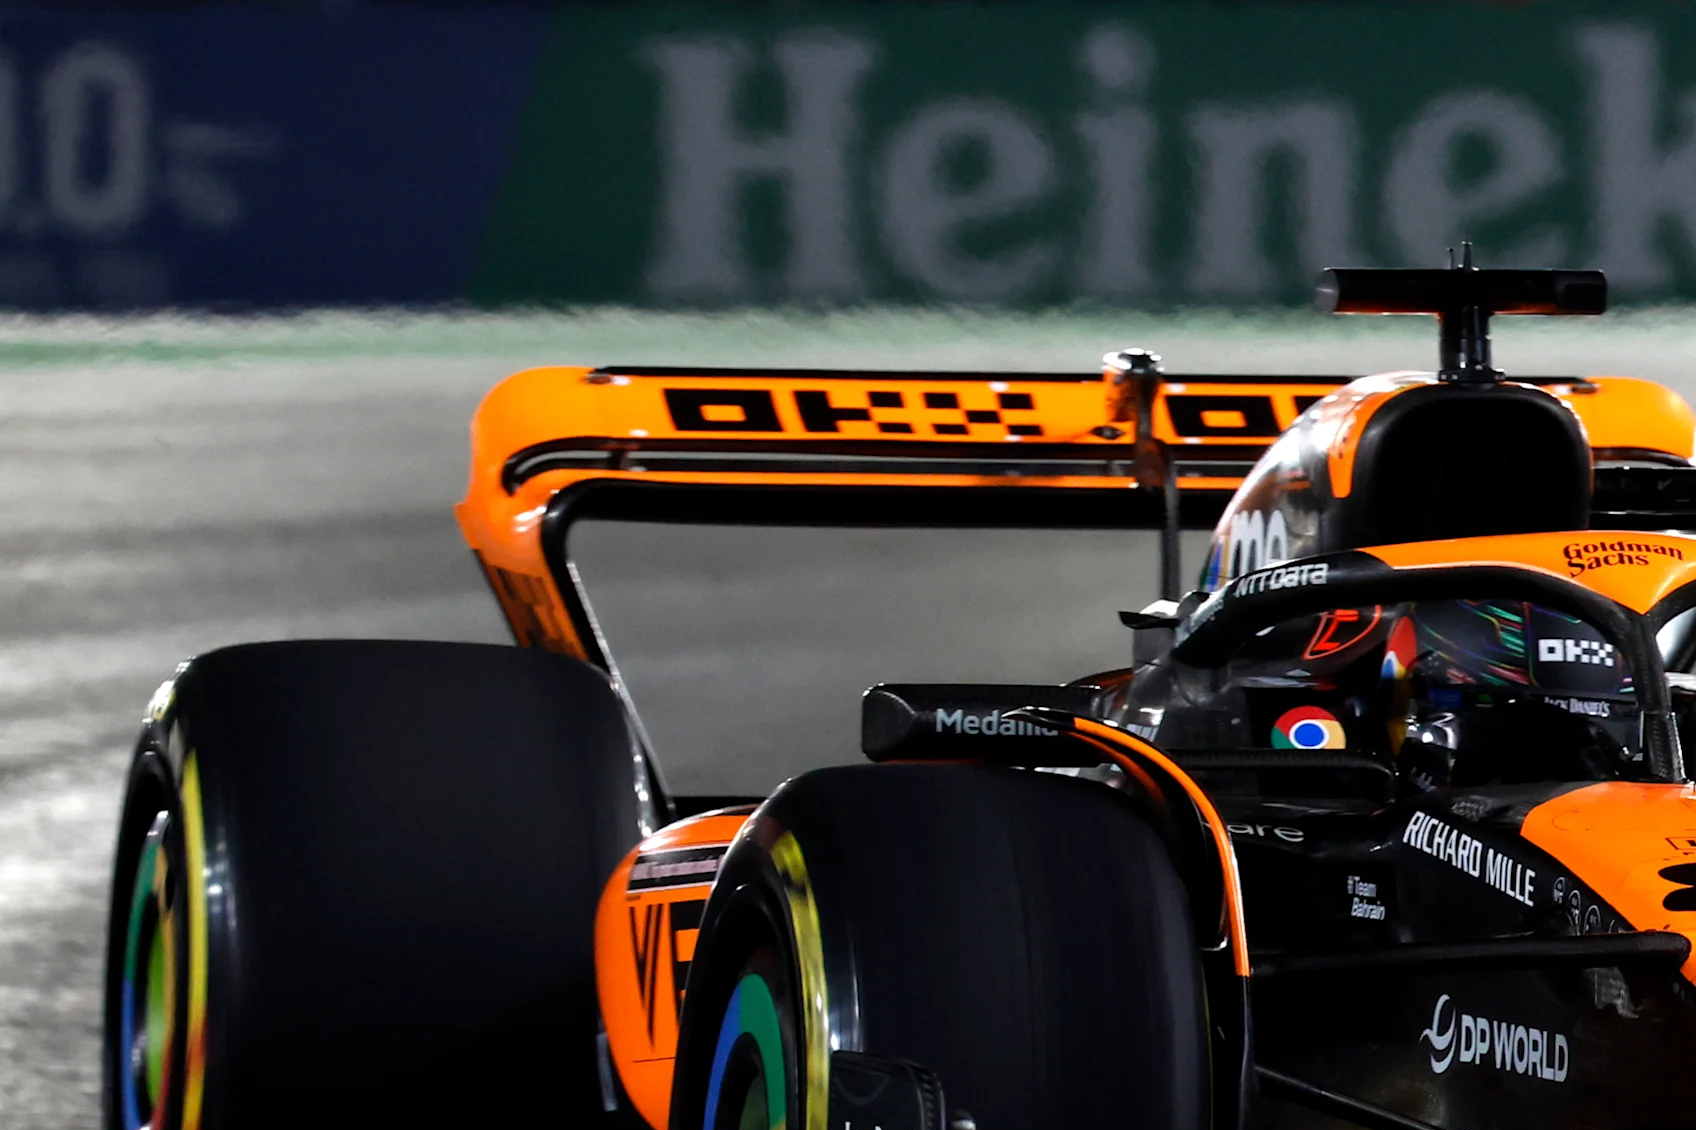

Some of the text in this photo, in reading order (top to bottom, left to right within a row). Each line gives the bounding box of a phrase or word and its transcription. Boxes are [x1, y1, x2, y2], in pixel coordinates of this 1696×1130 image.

[662, 387, 1046, 436] OKX
[1562, 541, 1684, 561] Goldman
[1566, 553, 1650, 578] Sachs
[1402, 810, 1536, 907] RICHARD MILLE
[1459, 1014, 1569, 1082] DP WORLD
